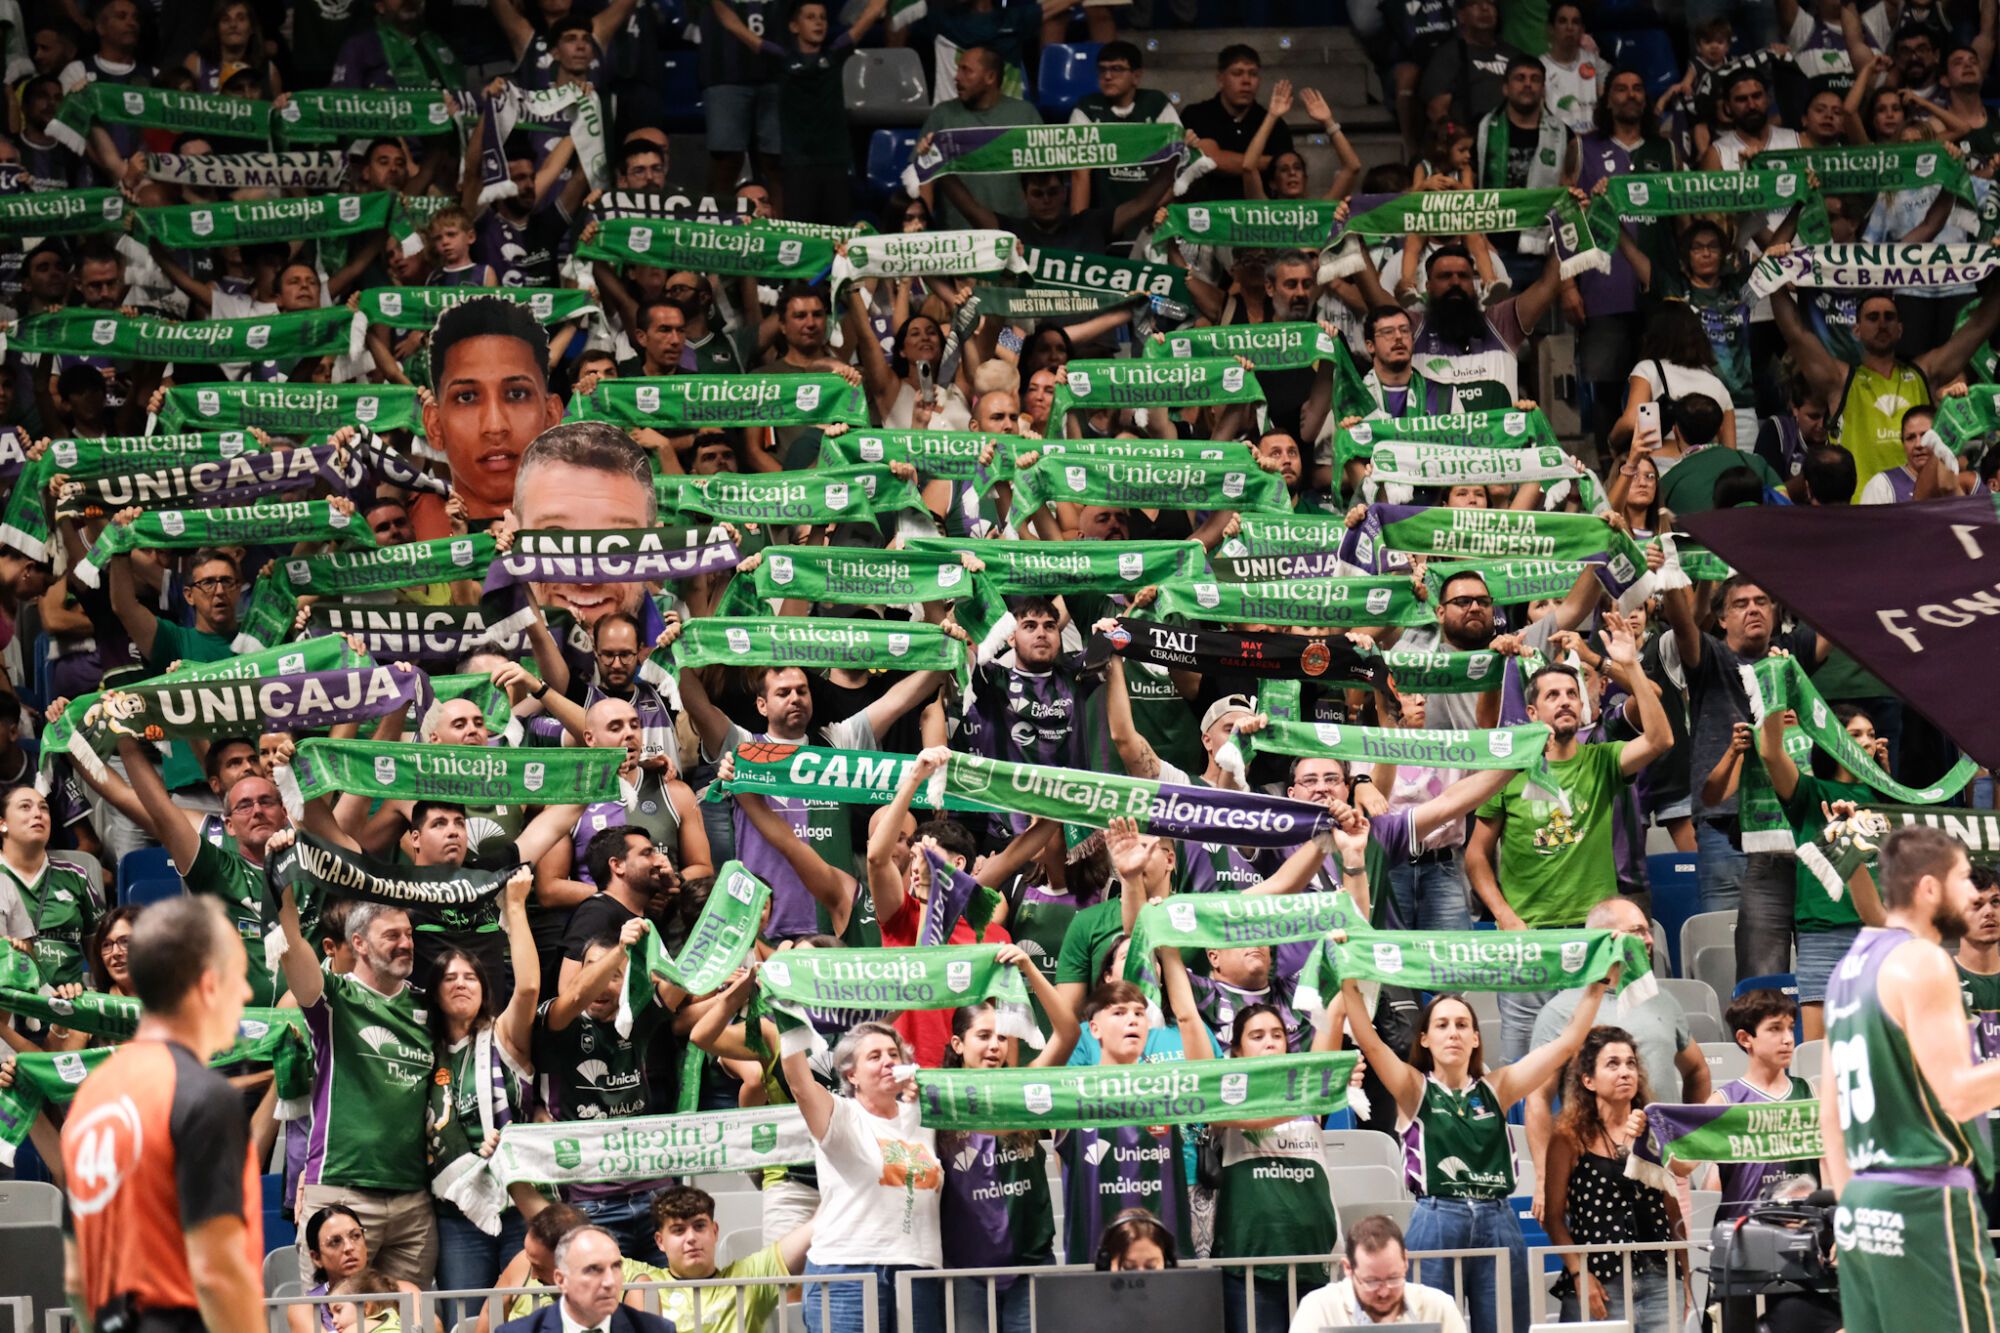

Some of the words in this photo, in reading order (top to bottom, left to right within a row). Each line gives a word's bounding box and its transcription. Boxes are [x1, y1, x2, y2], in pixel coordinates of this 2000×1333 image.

[748, 13, 765, 36] 6
[162, 93, 252, 120] Unicaja
[317, 94, 412, 119] Unicaja
[1027, 127, 1100, 148] UNICAJA
[1012, 143, 1117, 167] BALONCESTO
[1806, 152, 1899, 175] Unicaja
[1668, 175, 1760, 194] Unicaja
[0, 197, 86, 219] nicaja
[234, 200, 323, 221] Unicaja
[1421, 193, 1499, 211] UNICAJA
[1231, 206, 1319, 230] Unicaja
[1403, 209, 1517, 232] BALONCESTO
[675, 228, 765, 257] Unicaja
[1824, 244, 2000, 266] UNICAJA
[1010, 298, 1053, 313] NUESTRA
[1055, 297, 1100, 313] HISTORIA
[139, 323, 234, 344] Unicaja
[1210, 329, 1302, 355] Unicaja
[1109, 364, 1206, 389] Unicaja
[240, 389, 338, 414] Unicaja
[683, 380, 781, 406] Unicaja
[1395, 412, 1488, 434] Unicaja
[100, 432, 202, 455] Unicaja
[905, 433, 988, 456] Unicaj
[98, 447, 320, 505] UNICAJA
[1108, 465, 1206, 489] Unicaja
[703, 480, 808, 508] Unicaja
[205, 501, 310, 523] Unicaja
[1453, 511, 1536, 534] UNICAJA
[1249, 521, 1343, 549] Unicaja
[1433, 529, 1555, 556] BALONCESTO
[331, 542, 432, 569] Unicaja
[502, 526, 737, 577] UNICAJA
[1010, 552, 1090, 573] Unicaja
[827, 559, 909, 581] Unicaja
[1233, 555, 1338, 577] UNICAJA
[1241, 581, 1350, 608] Unicaja
[1506, 577, 1577, 598] histór
[1241, 598, 1351, 621] histórico
[329, 608, 556, 653] UNICA
[770, 624, 869, 647] Unicaja
[1150, 628, 1199, 653] TAU
[1241, 641, 1263, 650] MAY
[157, 666, 402, 725] UNICAJA
[1131, 681, 1179, 697] Unicaj
[1362, 738, 1476, 762] histórico
[415, 753, 507, 784] Unicaja
[734, 770, 776, 783] Unicaja
[415, 774, 511, 798] histórico
[1011, 765, 1119, 813] Unicaja
[1126, 787, 1295, 832] Baloncesto
[1225, 891, 1337, 919] Unicaja
[1224, 913, 1347, 942] histórico
[1429, 937, 1541, 965] Unicaja
[811, 956, 926, 985] Unicaja
[1430, 960, 1548, 986] histórico
[814, 978, 933, 1000] histórico
[1077, 1071, 1200, 1105] Unicaja
[1077, 1094, 1205, 1120] histórico
[1113, 1144, 1170, 1164] Unicaja
[1731, 1131, 1824, 1156] BALONCES
[982, 1147, 1035, 1167] Unicaja
